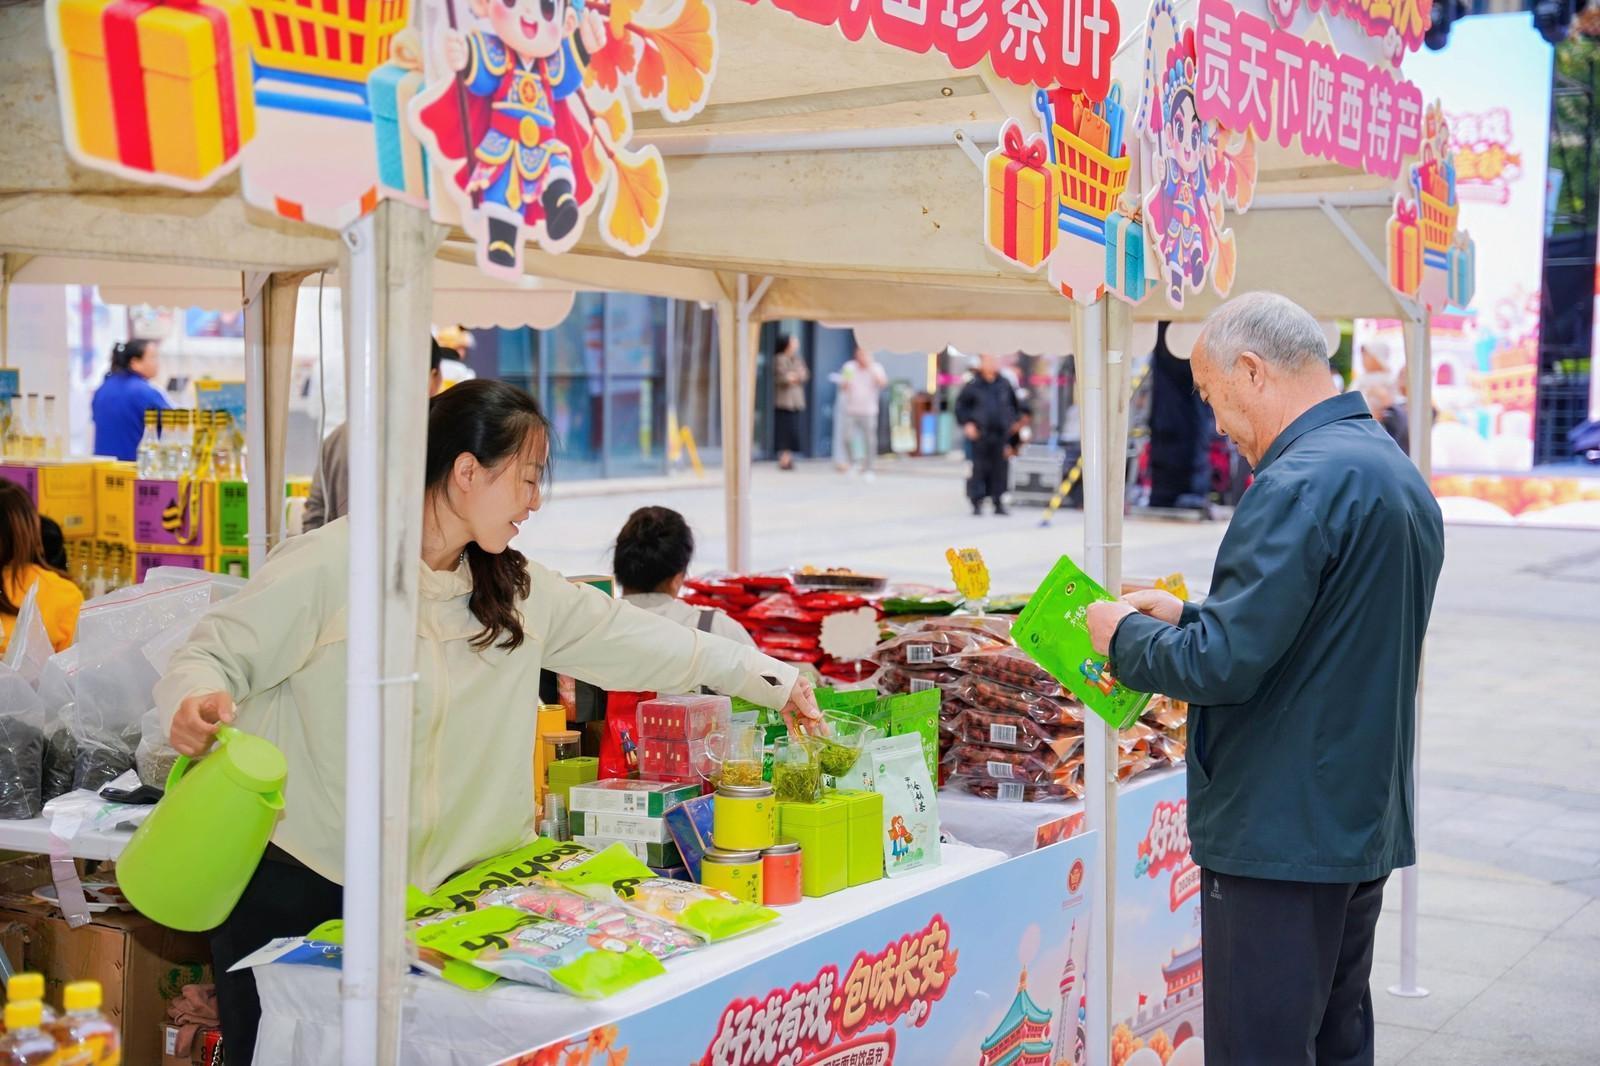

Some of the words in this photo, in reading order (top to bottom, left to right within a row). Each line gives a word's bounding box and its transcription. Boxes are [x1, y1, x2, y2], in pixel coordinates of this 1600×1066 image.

[1203, 14, 1419, 163] 贡天下陕西特产
[823, 1047, 884, 1066] 面包饮品节
